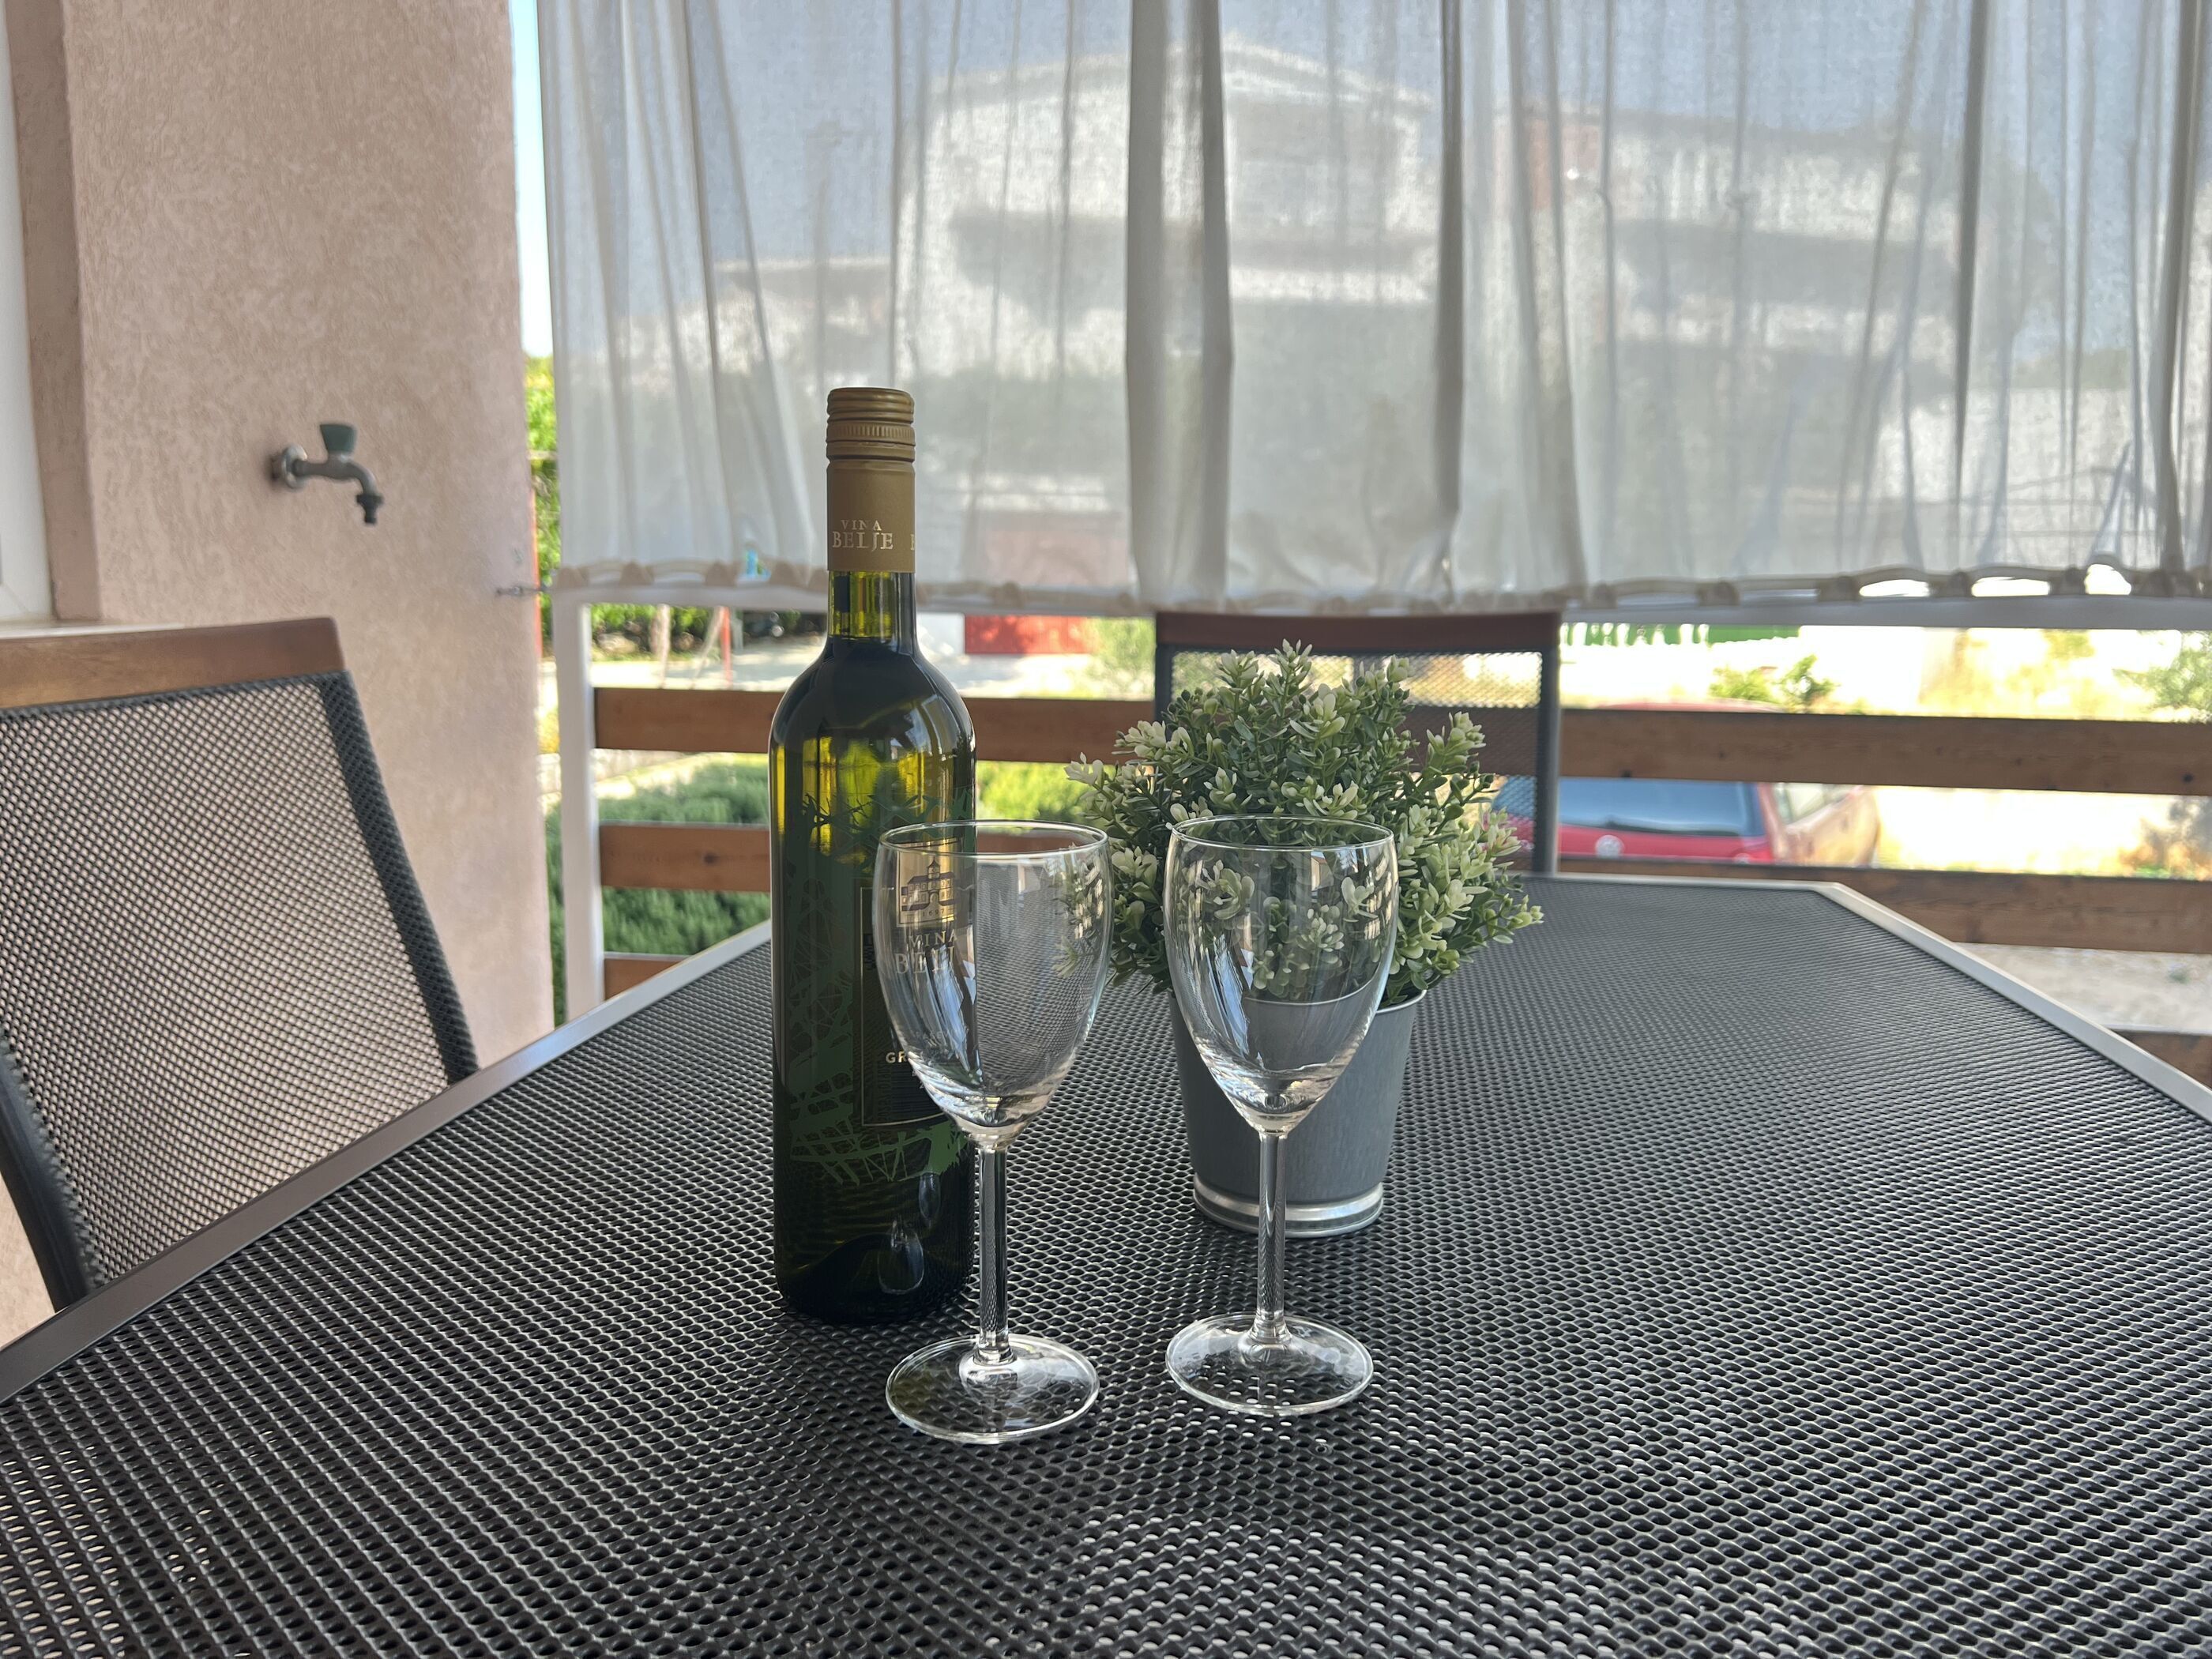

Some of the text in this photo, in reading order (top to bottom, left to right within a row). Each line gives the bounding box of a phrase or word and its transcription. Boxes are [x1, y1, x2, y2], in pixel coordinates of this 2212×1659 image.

[841, 520, 882, 531] VINA
[832, 531, 893, 552] BELJE
[908, 928, 957, 948] VINA
[894, 946, 956, 974] BELJ
